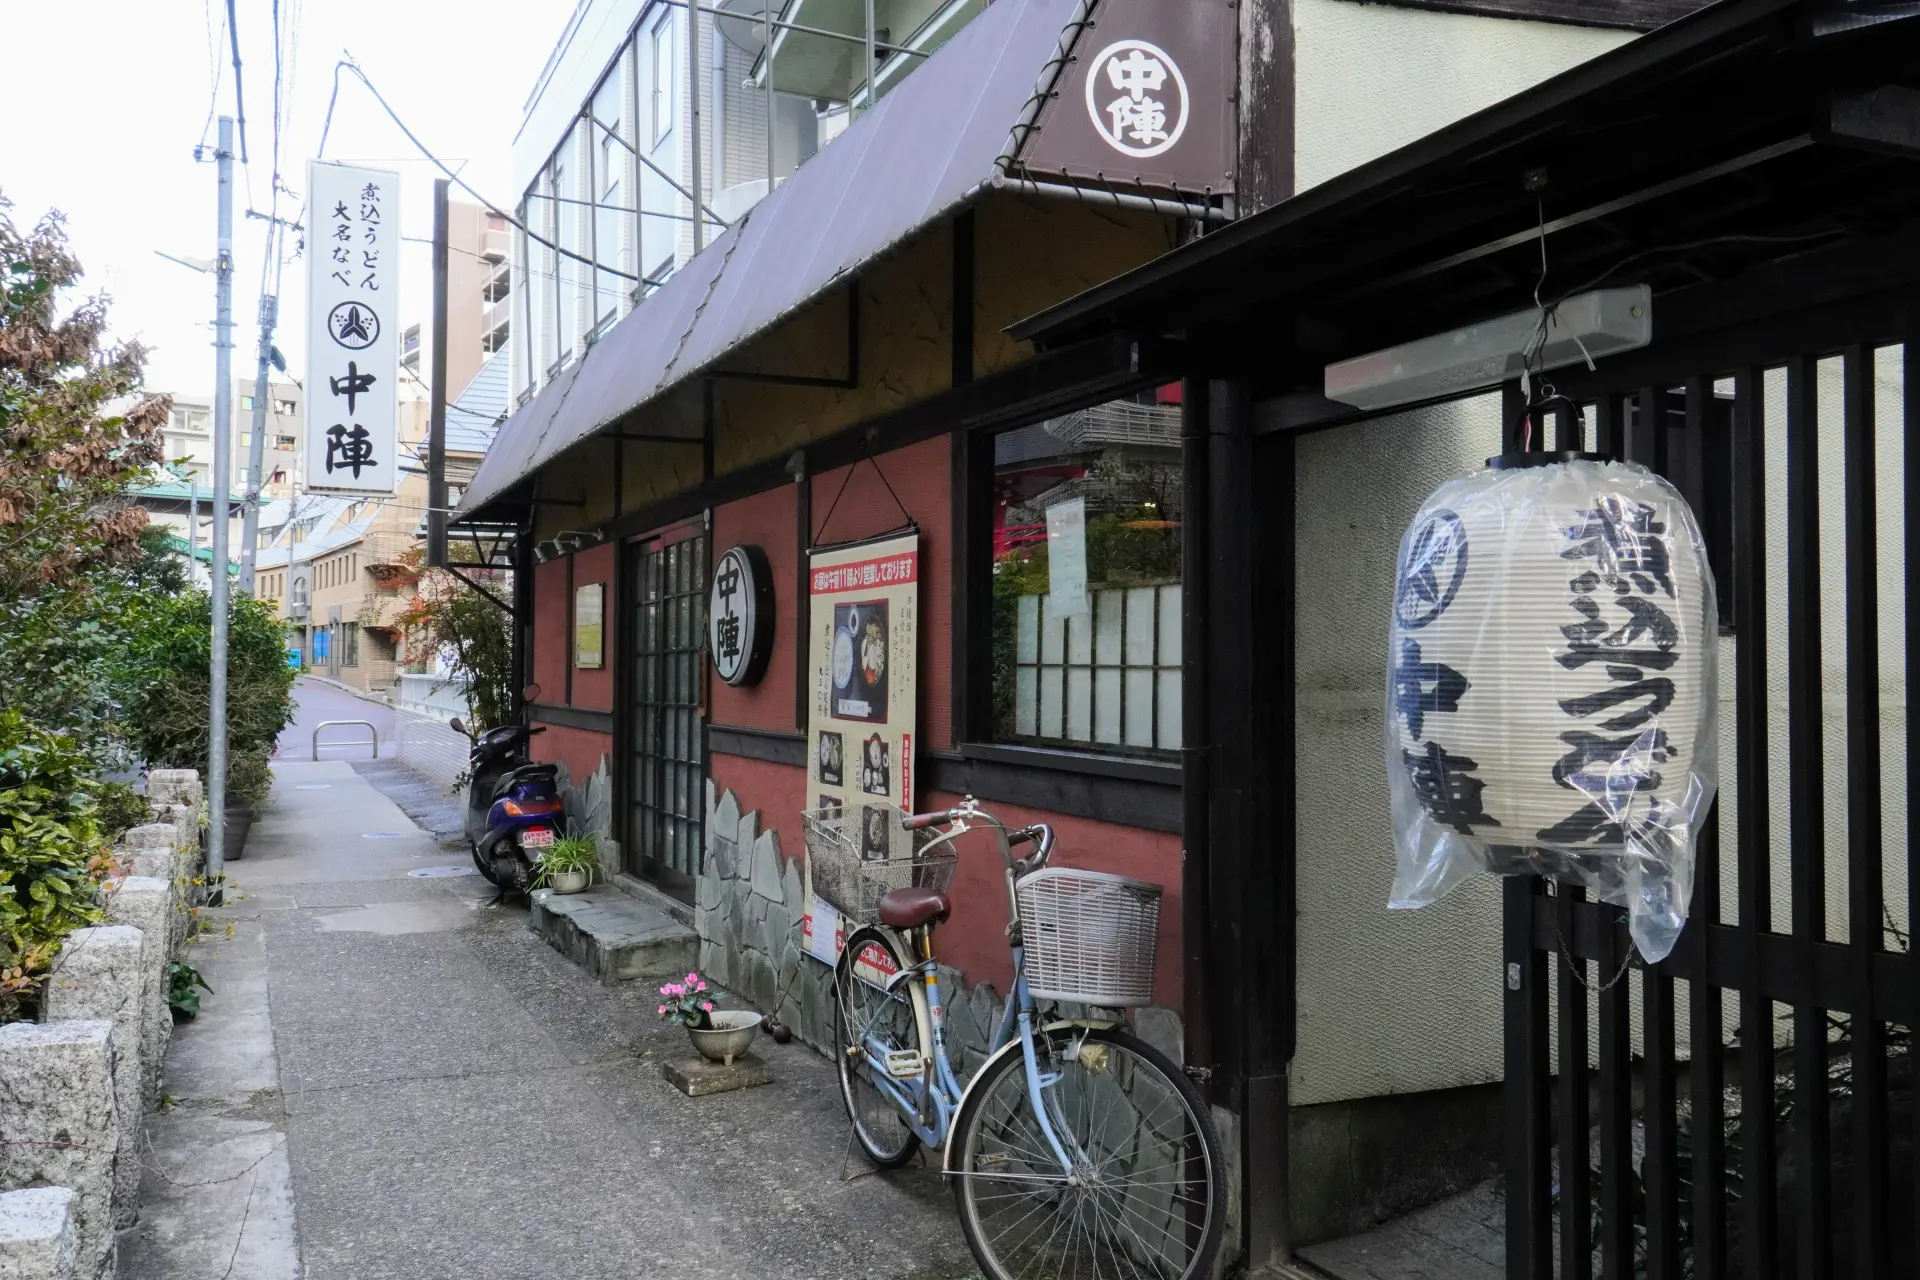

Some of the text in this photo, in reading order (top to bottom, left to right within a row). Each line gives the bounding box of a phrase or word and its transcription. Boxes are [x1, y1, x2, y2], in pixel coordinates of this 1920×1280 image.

[1106, 50, 1169, 145] 中陣
[331, 200, 351, 287] 大名なべ
[359, 182, 380, 291] 煮込うどん
[326, 361, 378, 480] 中陣
[717, 557, 740, 668] 中陣
[1535, 496, 1680, 846] 煮込うどん
